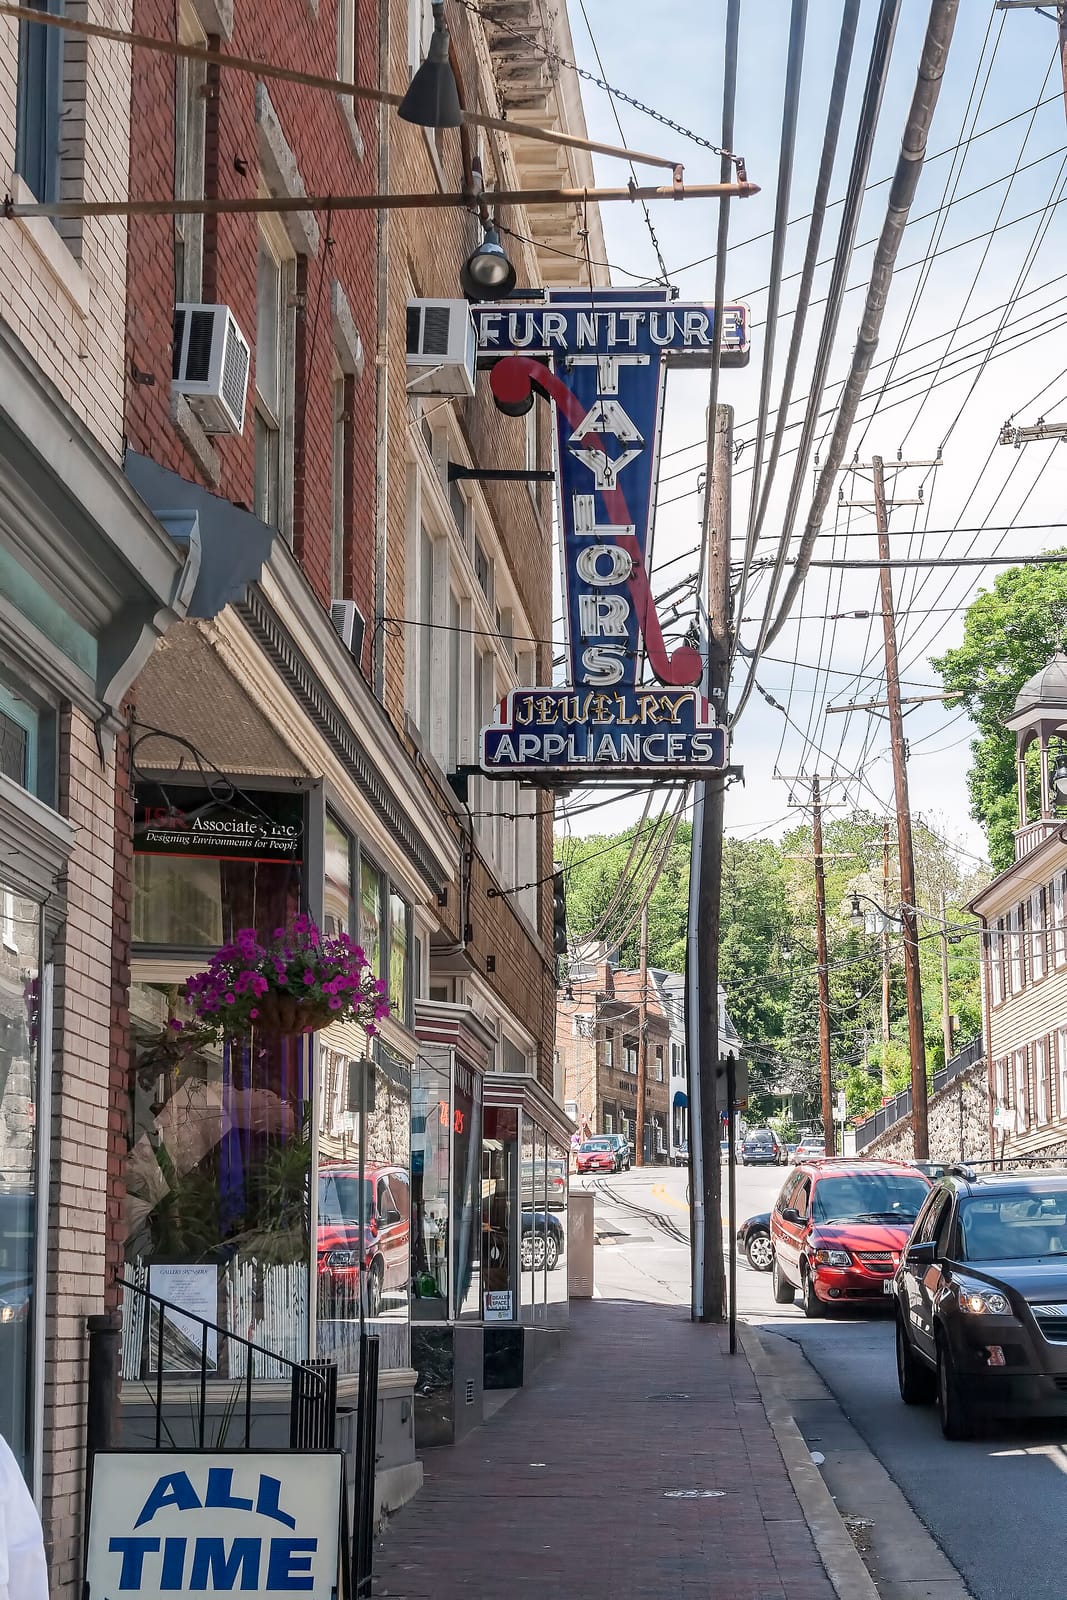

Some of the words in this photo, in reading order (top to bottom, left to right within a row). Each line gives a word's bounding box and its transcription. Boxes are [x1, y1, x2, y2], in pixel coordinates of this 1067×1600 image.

[479, 311, 741, 348] FURNITURE
[564, 355, 650, 686] TAYLORS
[516, 691, 694, 726] JEWELRY
[490, 733, 713, 763] APPLIANCES
[146, 832, 190, 845] Designing
[192, 835, 253, 848] Environments
[254, 839, 268, 848] for
[133, 1467, 296, 1531] ALL
[108, 1537, 318, 1591] TIME
